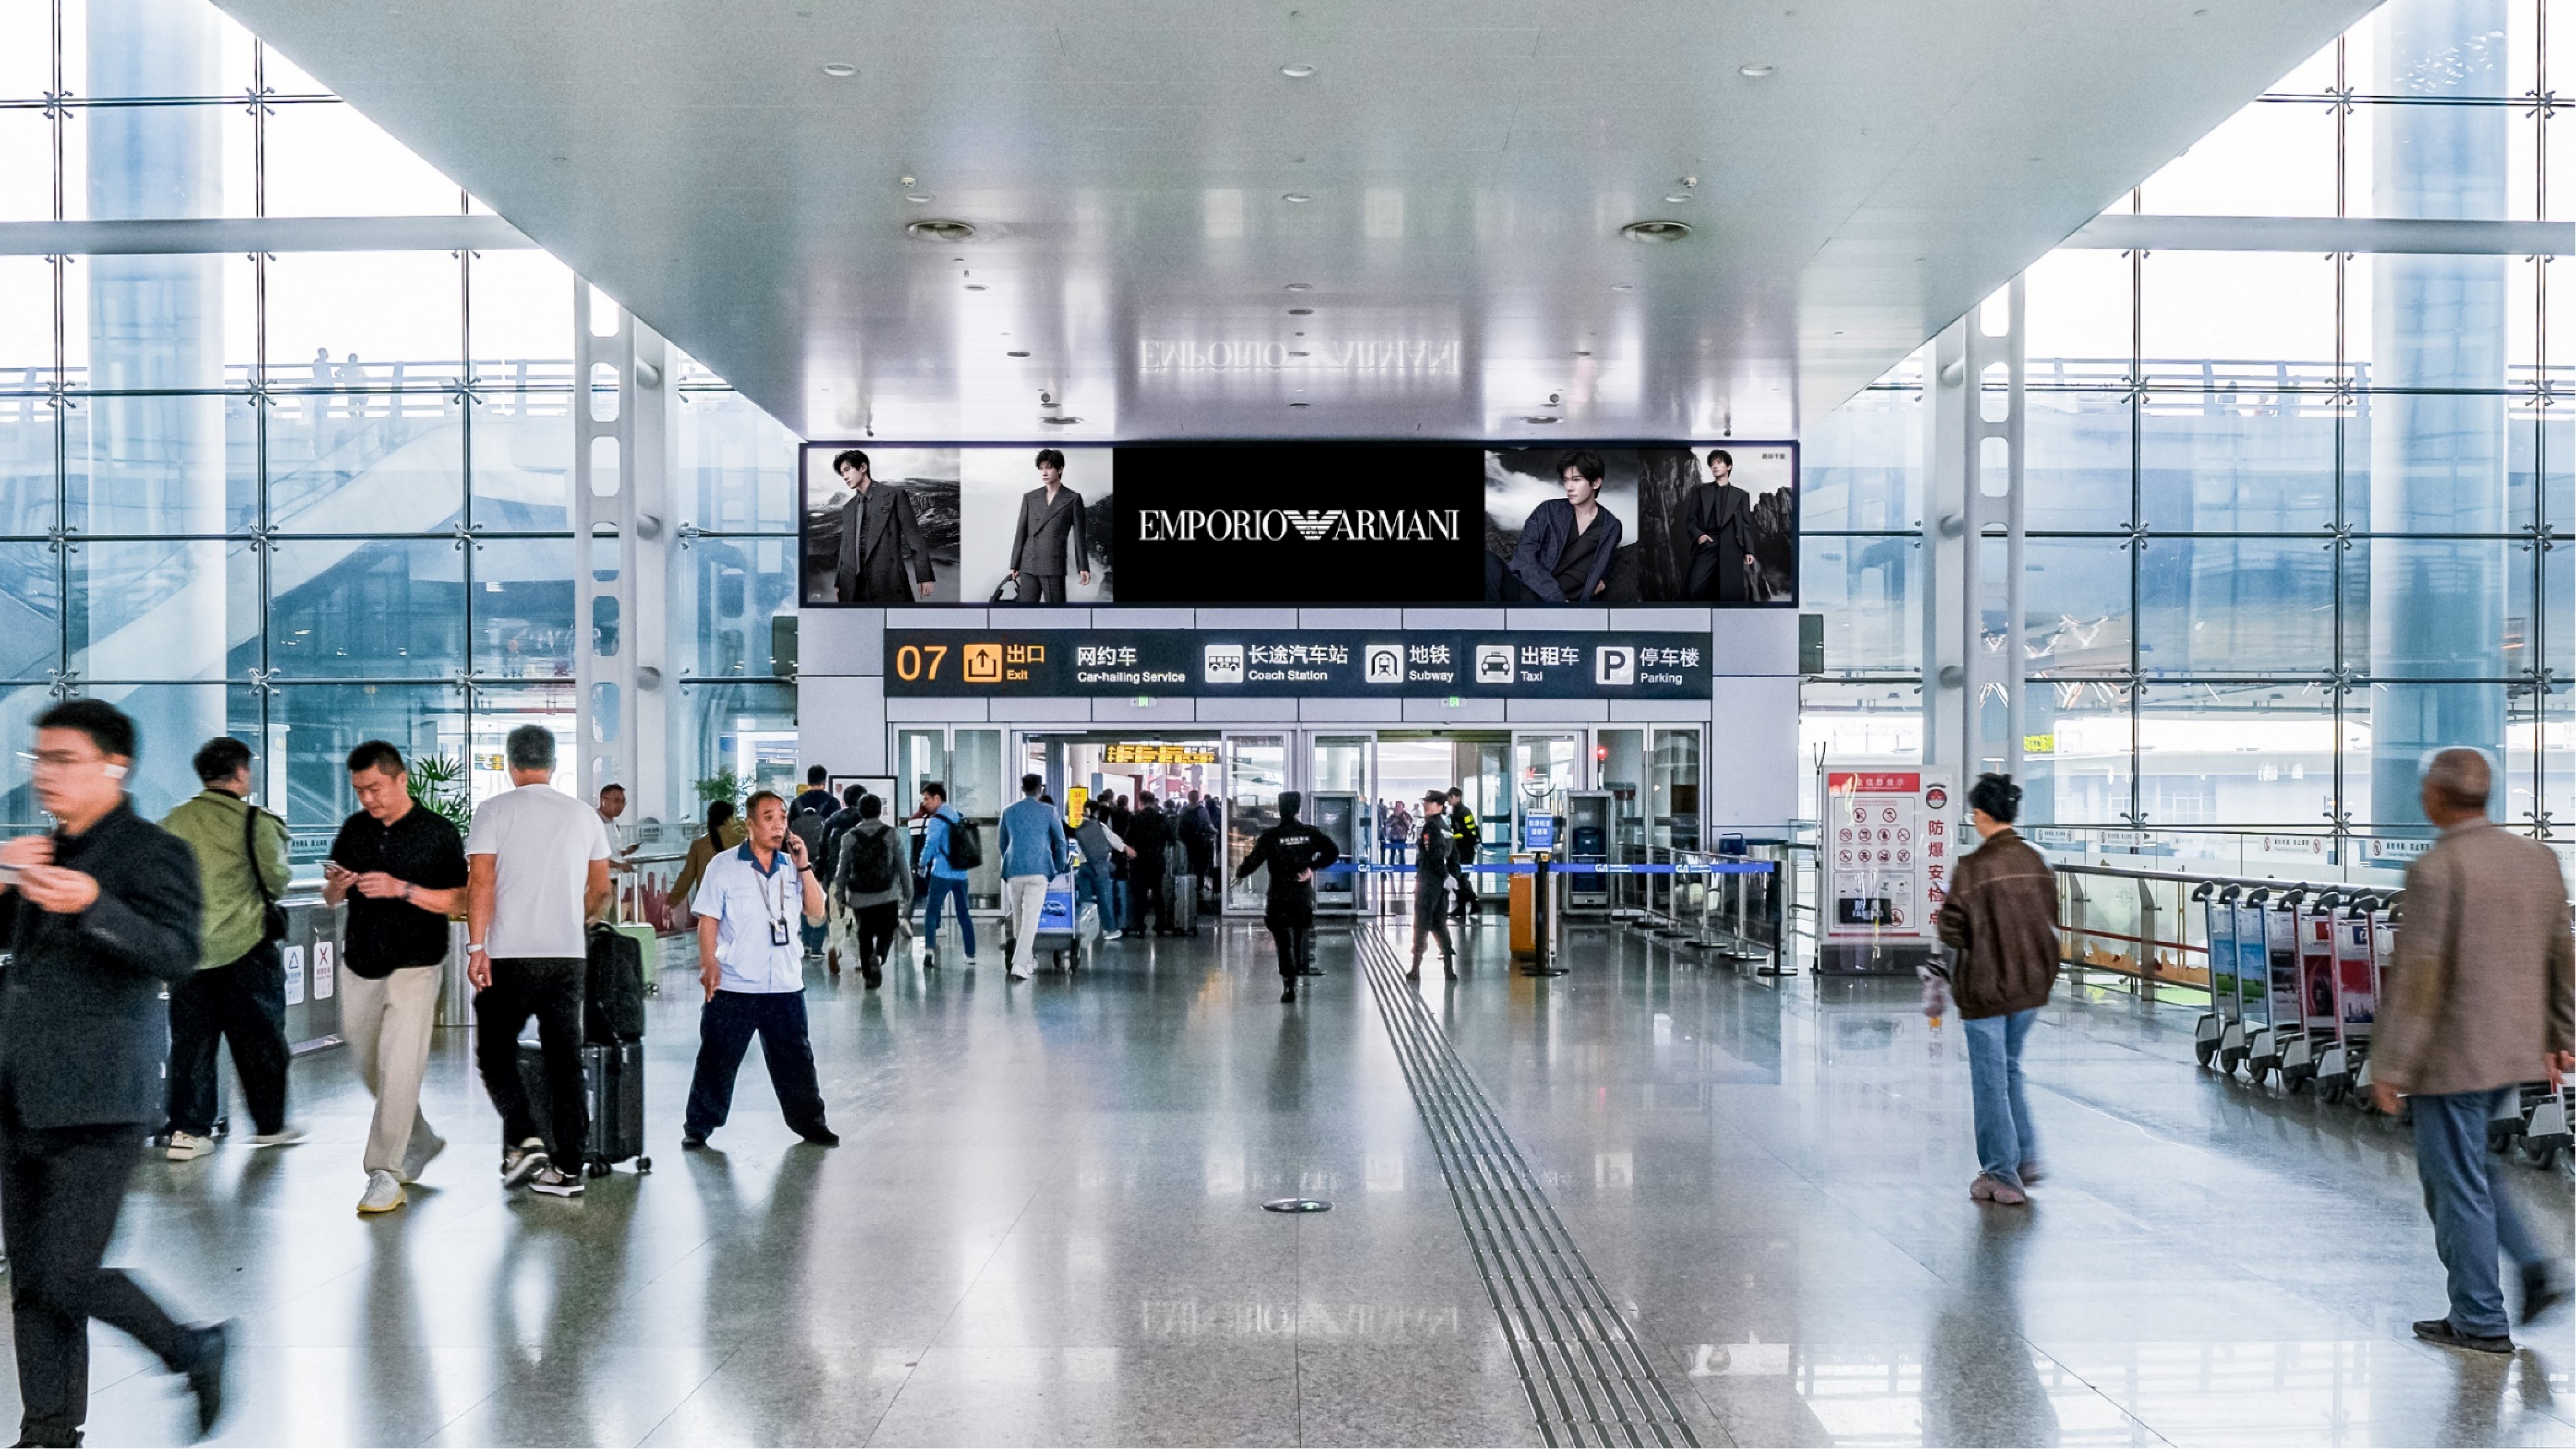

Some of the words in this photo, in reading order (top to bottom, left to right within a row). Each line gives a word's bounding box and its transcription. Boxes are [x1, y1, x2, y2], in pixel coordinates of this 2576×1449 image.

[1138, 509, 1288, 541] EMPORIO
[1332, 509, 1460, 541] ARMANI
[896, 645, 948, 681] 07
[1007, 643, 1045, 664] 出口
[1077, 645, 1137, 667] 网约车
[1248, 644, 1349, 664] 长途汽车站
[1409, 644, 1450, 664] 地铁
[1521, 645, 1580, 667] 出租车
[1639, 647, 1700, 668] 停车楼
[1007, 669, 1028, 680] Exit
[1077, 671, 1141, 685] Car-hailing
[1142, 671, 1186, 682] Service
[1248, 669, 1285, 681] Coach
[1287, 670, 1328, 681] Station
[1409, 670, 1455, 684] Subway
[1520, 671, 1543, 682] Taxi
[1640, 672, 1683, 686] Parking
